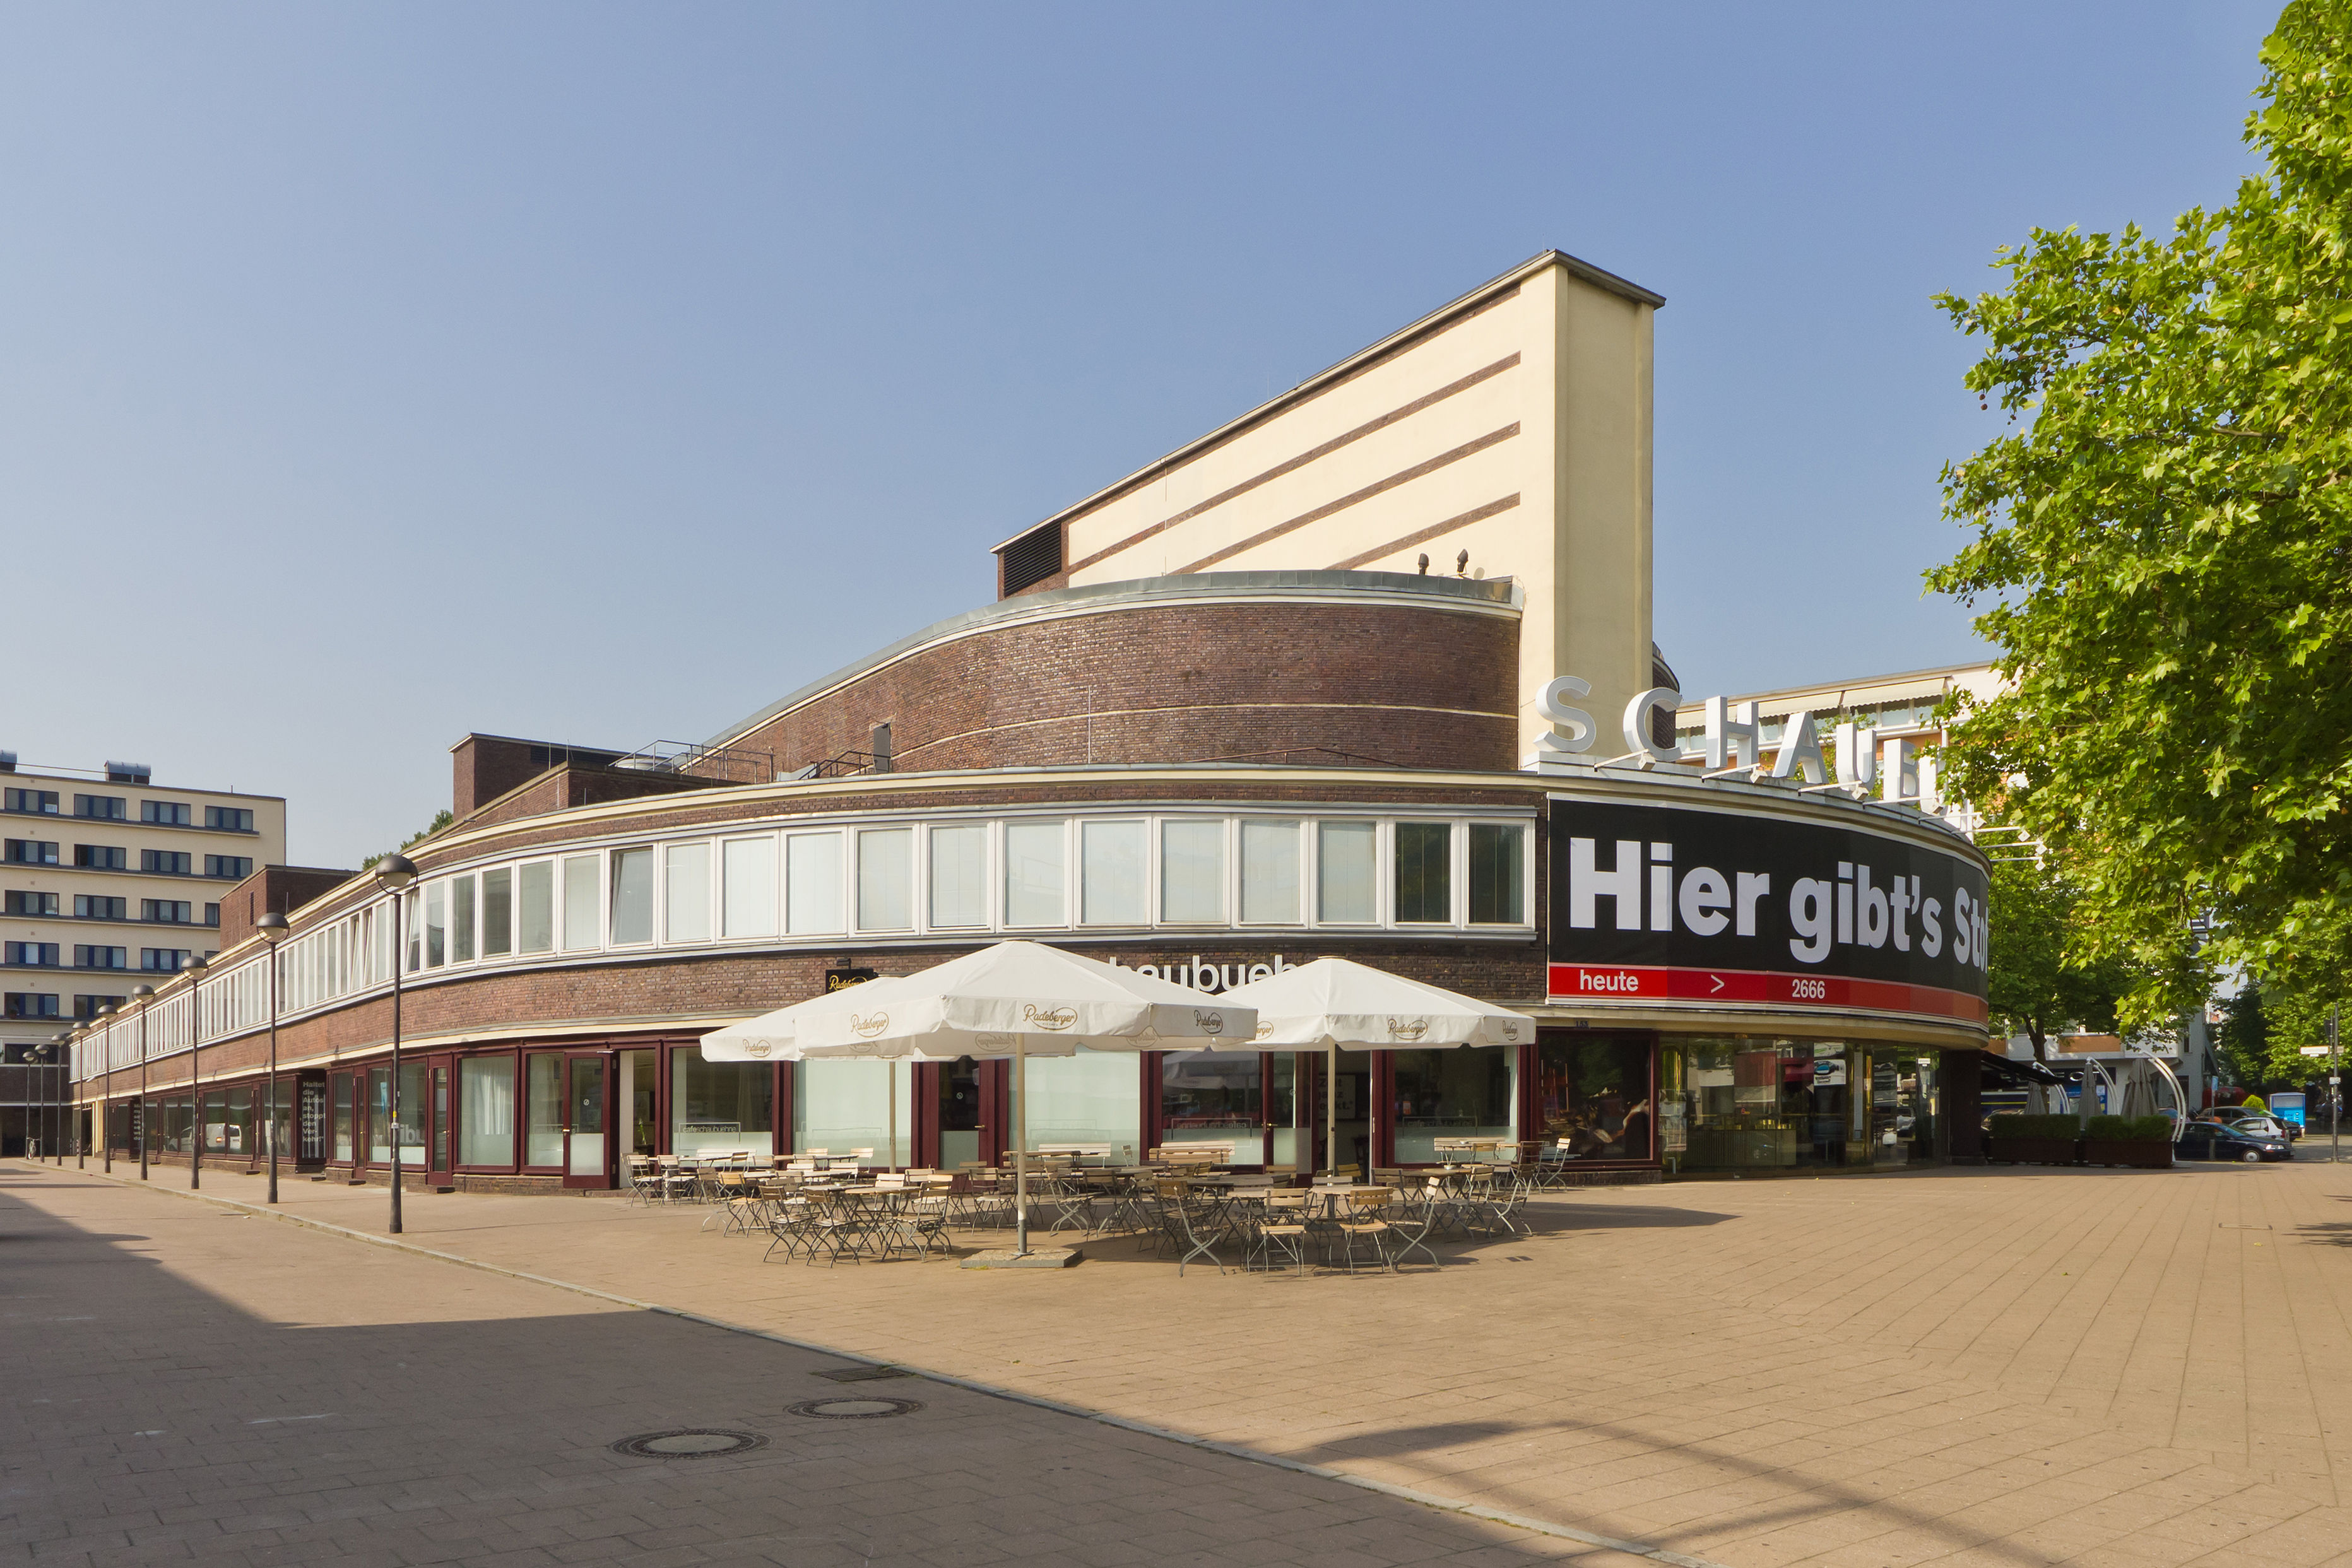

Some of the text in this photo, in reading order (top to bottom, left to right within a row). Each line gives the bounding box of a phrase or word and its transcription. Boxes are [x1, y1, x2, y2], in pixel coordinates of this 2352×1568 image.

[1534, 675, 1973, 844] SCHAUB
[1569, 837, 1770, 937] Hier
[1789, 861, 1942, 964] gibt's
[1580, 969, 1639, 992] heute
[1791, 979, 1826, 1000] 2666
[1023, 1004, 1078, 1027] Radeberger
[1388, 1018, 1428, 1037] Radeberger
